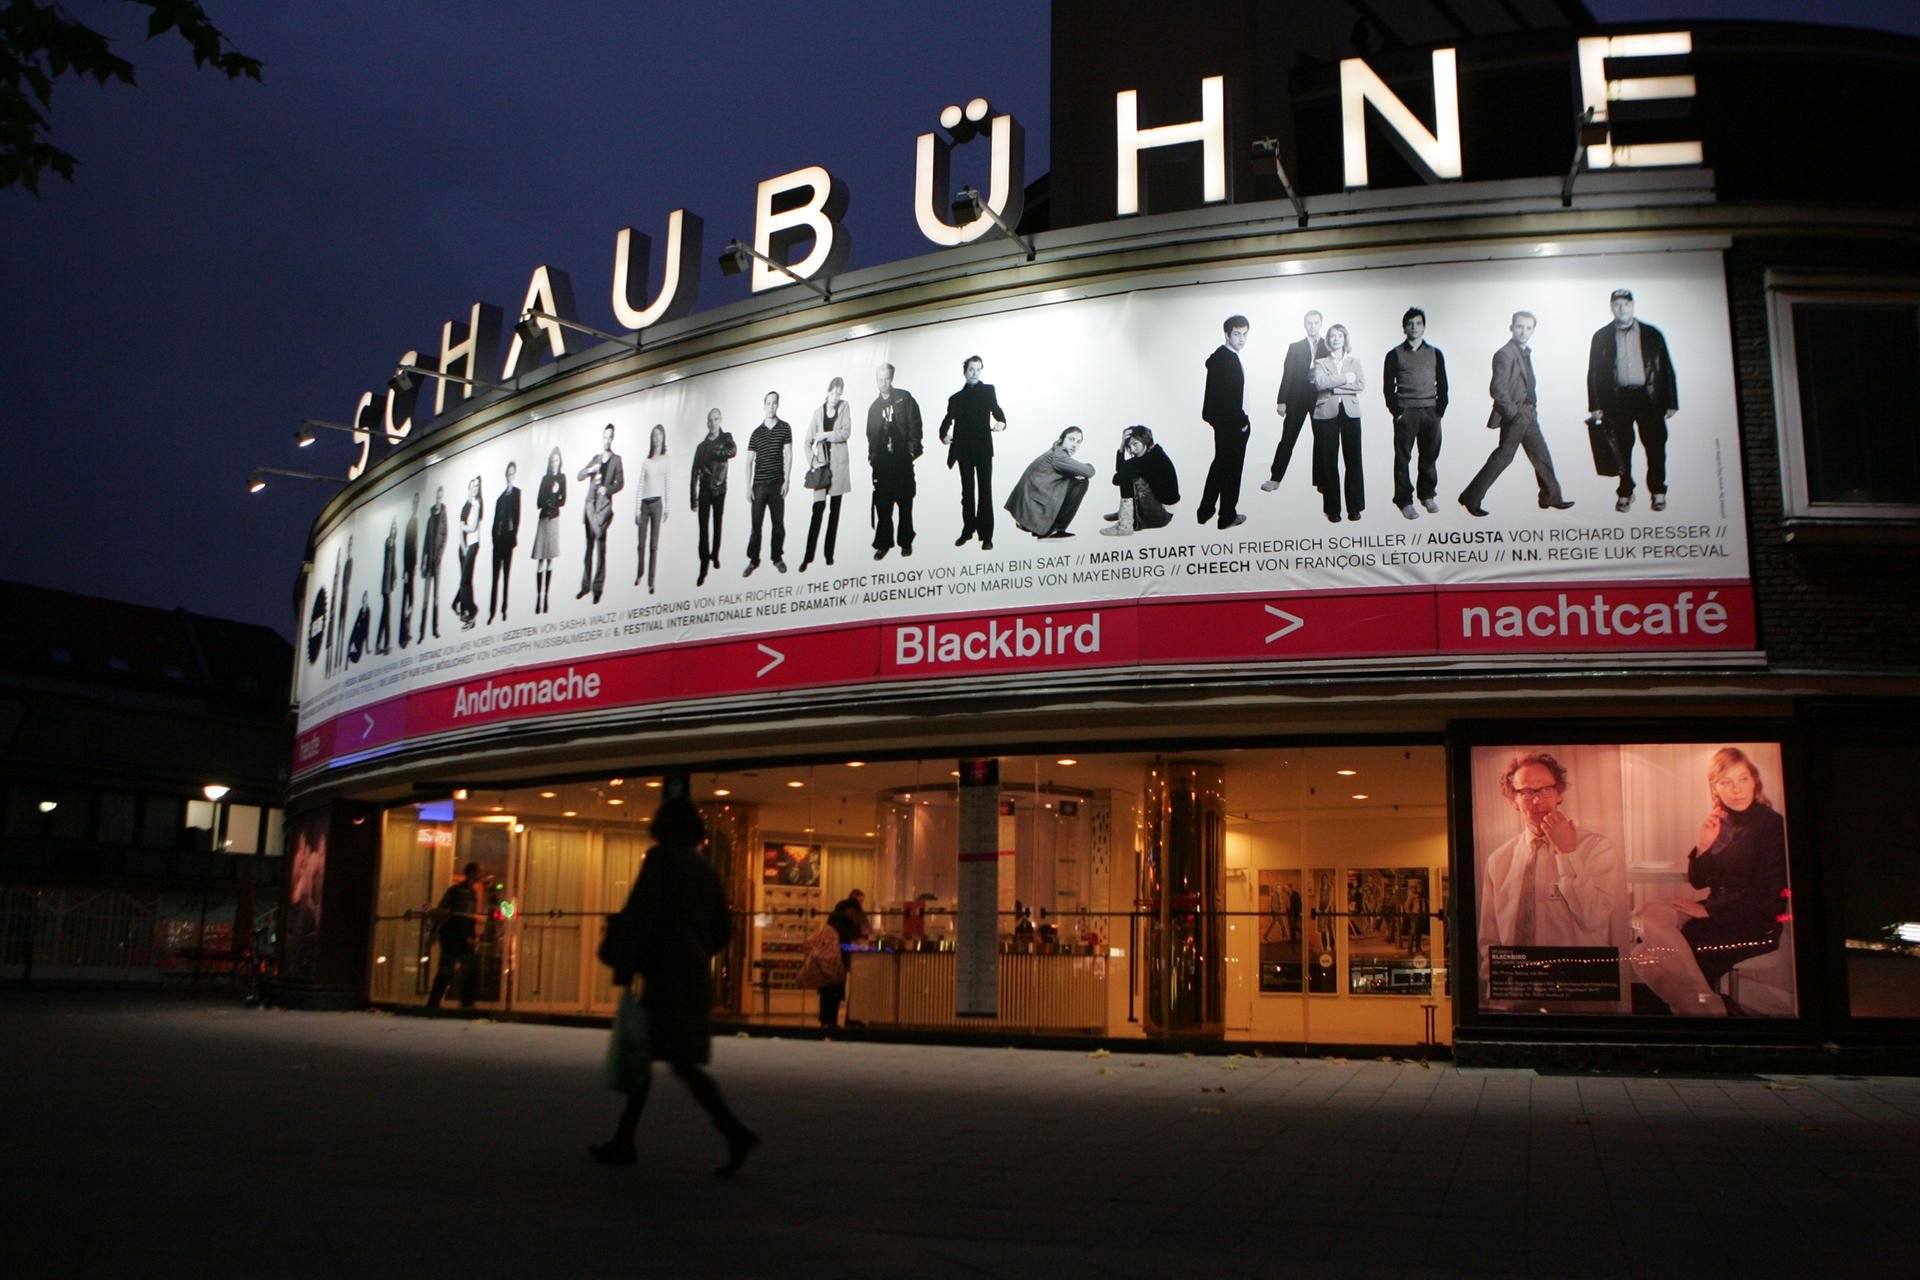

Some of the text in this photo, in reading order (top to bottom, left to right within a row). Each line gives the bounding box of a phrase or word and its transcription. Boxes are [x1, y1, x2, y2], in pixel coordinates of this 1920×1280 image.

[347, 30, 1704, 482] SCHAUBÜHNE
[541, 623, 557, 634] VON
[560, 619, 586, 631] SASHA
[589, 612, 617, 625] WALTZ
[627, 600, 690, 619] VERSTÖRUNG
[693, 596, 715, 609] VON
[718, 592, 742, 606] FALK
[746, 586, 792, 602] RICHTER
[807, 581, 829, 594] THE
[833, 575, 867, 590] OPTIC
[871, 569, 924, 585] TRILOGY
[928, 566, 956, 579] VON
[960, 562, 1004, 577] ALFIAN
[1009, 560, 1032, 572] BIN
[1037, 555, 1071, 569] SA'AT
[1090, 550, 1133, 564] MARIA
[1139, 545, 1196, 560] STUART
[1201, 543, 1233, 556] VON
[1239, 538, 1322, 554] FRIEDRICH
[1328, 534, 1406, 550] SCHILLER
[1427, 530, 1504, 545] AUGUSTA
[1509, 529, 1544, 543] VON
[1549, 527, 1625, 542] RICHARD
[1631, 525, 1710, 540] DRESSER
[623, 619, 663, 635] FESTIVAL
[667, 607, 753, 628] INTERNATIONALE
[756, 602, 787, 617] NEUE
[791, 596, 847, 613] DRAMATIK
[863, 585, 943, 603] AUGENLICHT
[948, 582, 976, 595] VON
[981, 577, 1033, 593] MARIUS
[1038, 573, 1067, 586] VON
[1073, 565, 1165, 584] MAYENBURG
[1186, 560, 1250, 575] CHEECH
[1256, 558, 1289, 572] VON
[1295, 554, 1376, 570] FRANÇOIS
[1382, 550, 1488, 566] LÉTOURNEAU
[1512, 548, 1542, 562] N.N.
[1548, 546, 1599, 561] REGIE
[1605, 545, 1636, 560] LUK
[1642, 543, 1728, 559] PERCEVAL
[1462, 591, 1728, 638] nachtcafé
[896, 612, 1101, 665] Blackbird
[453, 668, 601, 718] Andromache
